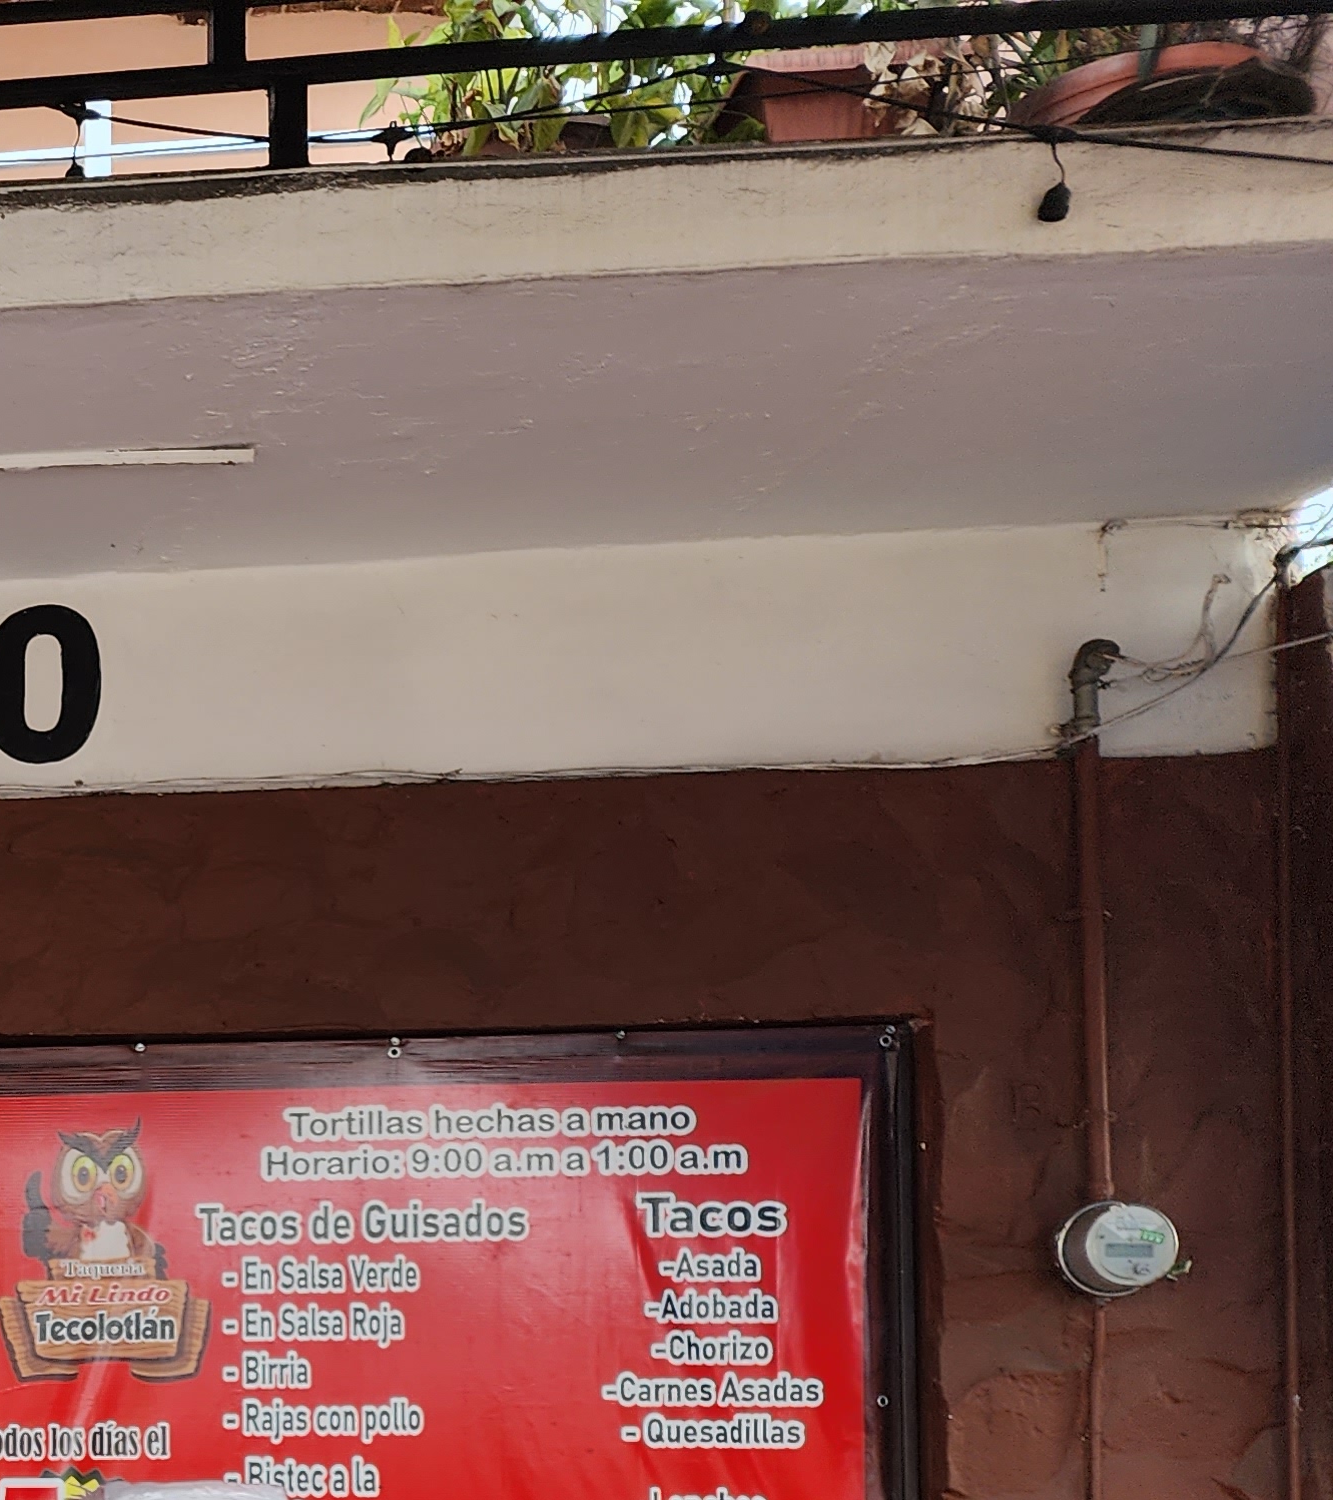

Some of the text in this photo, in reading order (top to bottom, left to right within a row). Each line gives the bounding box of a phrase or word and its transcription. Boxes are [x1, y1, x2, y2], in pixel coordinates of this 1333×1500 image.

[287, 1107, 692, 1138] Tortillas hechas a mano
[265, 1143, 744, 1177] Horario: 9:00 a.m a 1:00 a.m
[198, 1201, 527, 1242] Tacos de Guisados
[640, 1196, 782, 1234] Tacos
[64, 1260, 143, 1278] Taqueria
[244, 1258, 418, 1291] En Salsa Verde
[39, 1284, 170, 1304] Mi Lindo
[35, 1310, 176, 1342] Tecolotlán
[244, 1306, 402, 1344] En Salsa Roja
[244, 1354, 309, 1386] Birria
[720, 1376, 820, 1403] Asadas
[245, 1401, 421, 1441] Rajas con pollo
[646, 1417, 801, 1445] Quesadillas
[50, 1426, 84, 1458] los
[90, 1423, 139, 1458] días
[146, 1424, 168, 1457] el
[248, 1461, 376, 1492] Bistec a la
